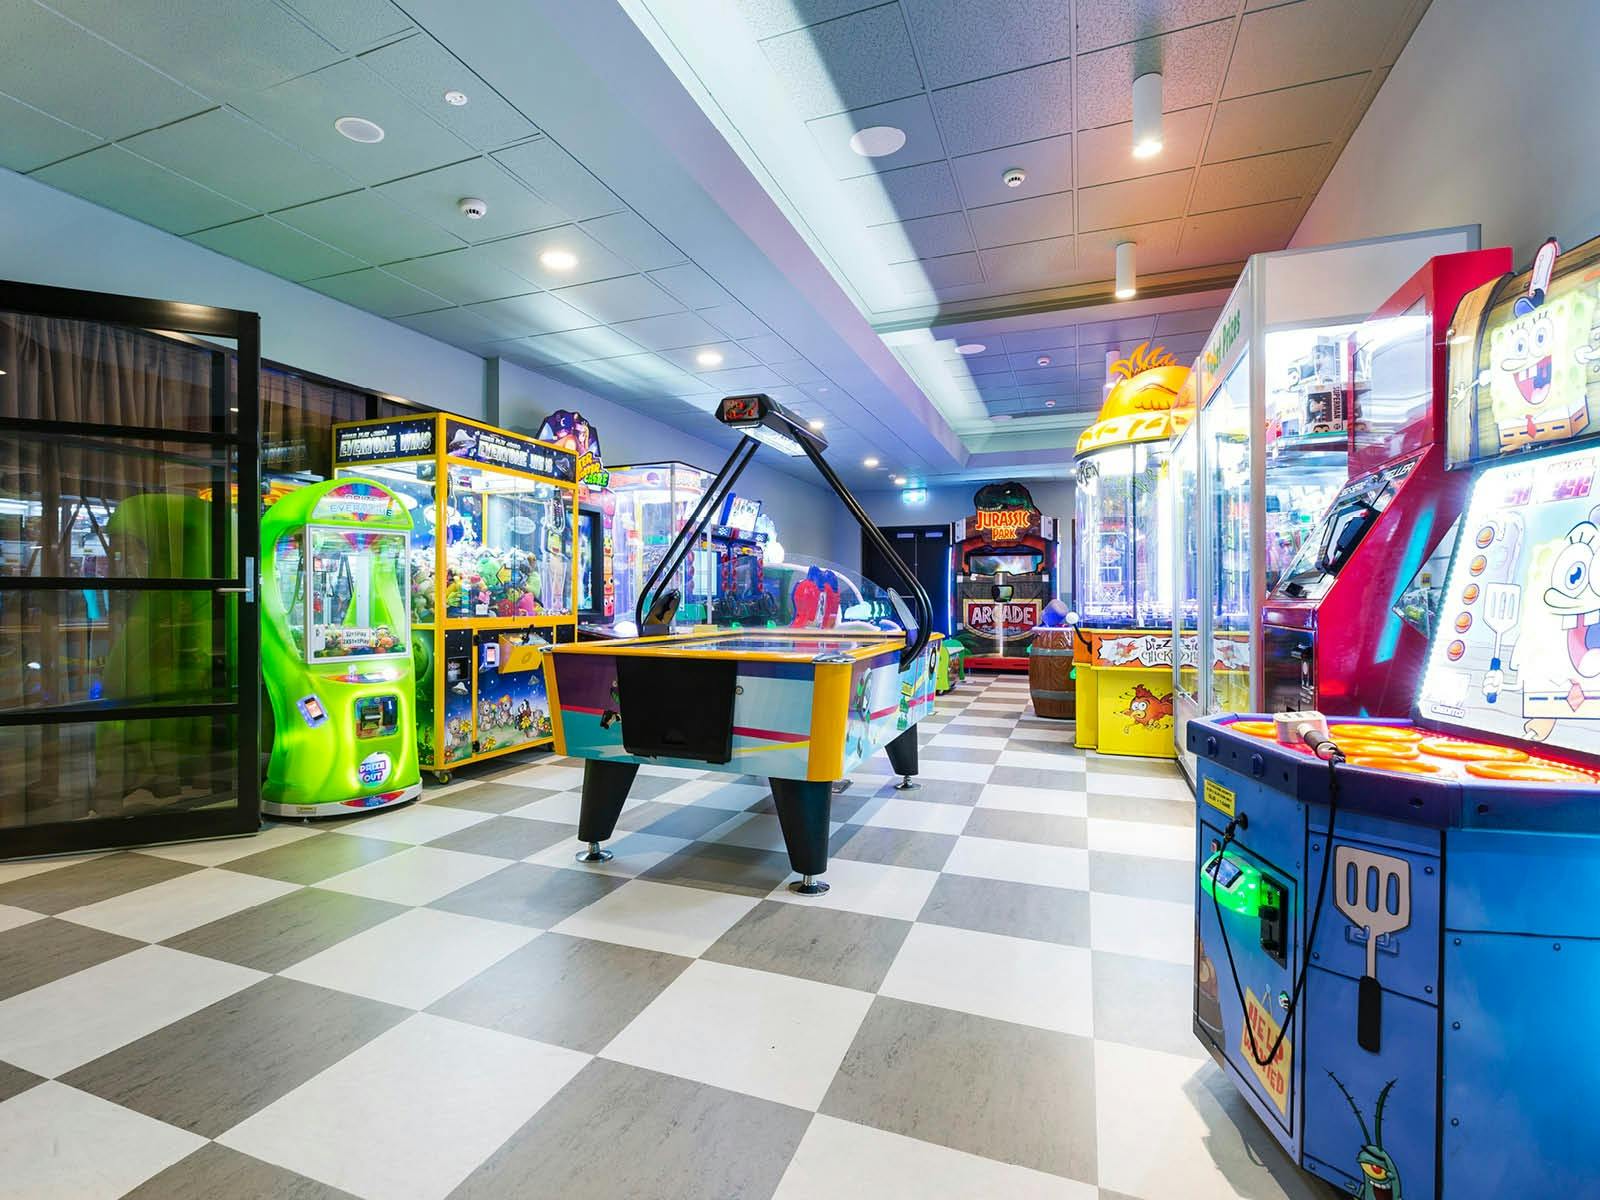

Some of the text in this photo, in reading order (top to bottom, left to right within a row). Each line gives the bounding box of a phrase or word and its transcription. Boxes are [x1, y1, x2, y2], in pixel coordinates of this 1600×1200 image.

[1332, 386, 1342, 419] SUPERMAN
[340, 431, 432, 457] EVERYONE WINS
[478, 440, 528, 467] EVERYONE
[584, 472, 609, 486] CASTLE
[975, 510, 1030, 530] JURASSIC
[991, 527, 1017, 540] PARK
[971, 605, 1034, 625] ARCADE
[1141, 650, 1173, 663] CHICK
[359, 760, 386, 773] PRIZE
[363, 771, 383, 783] OUT
